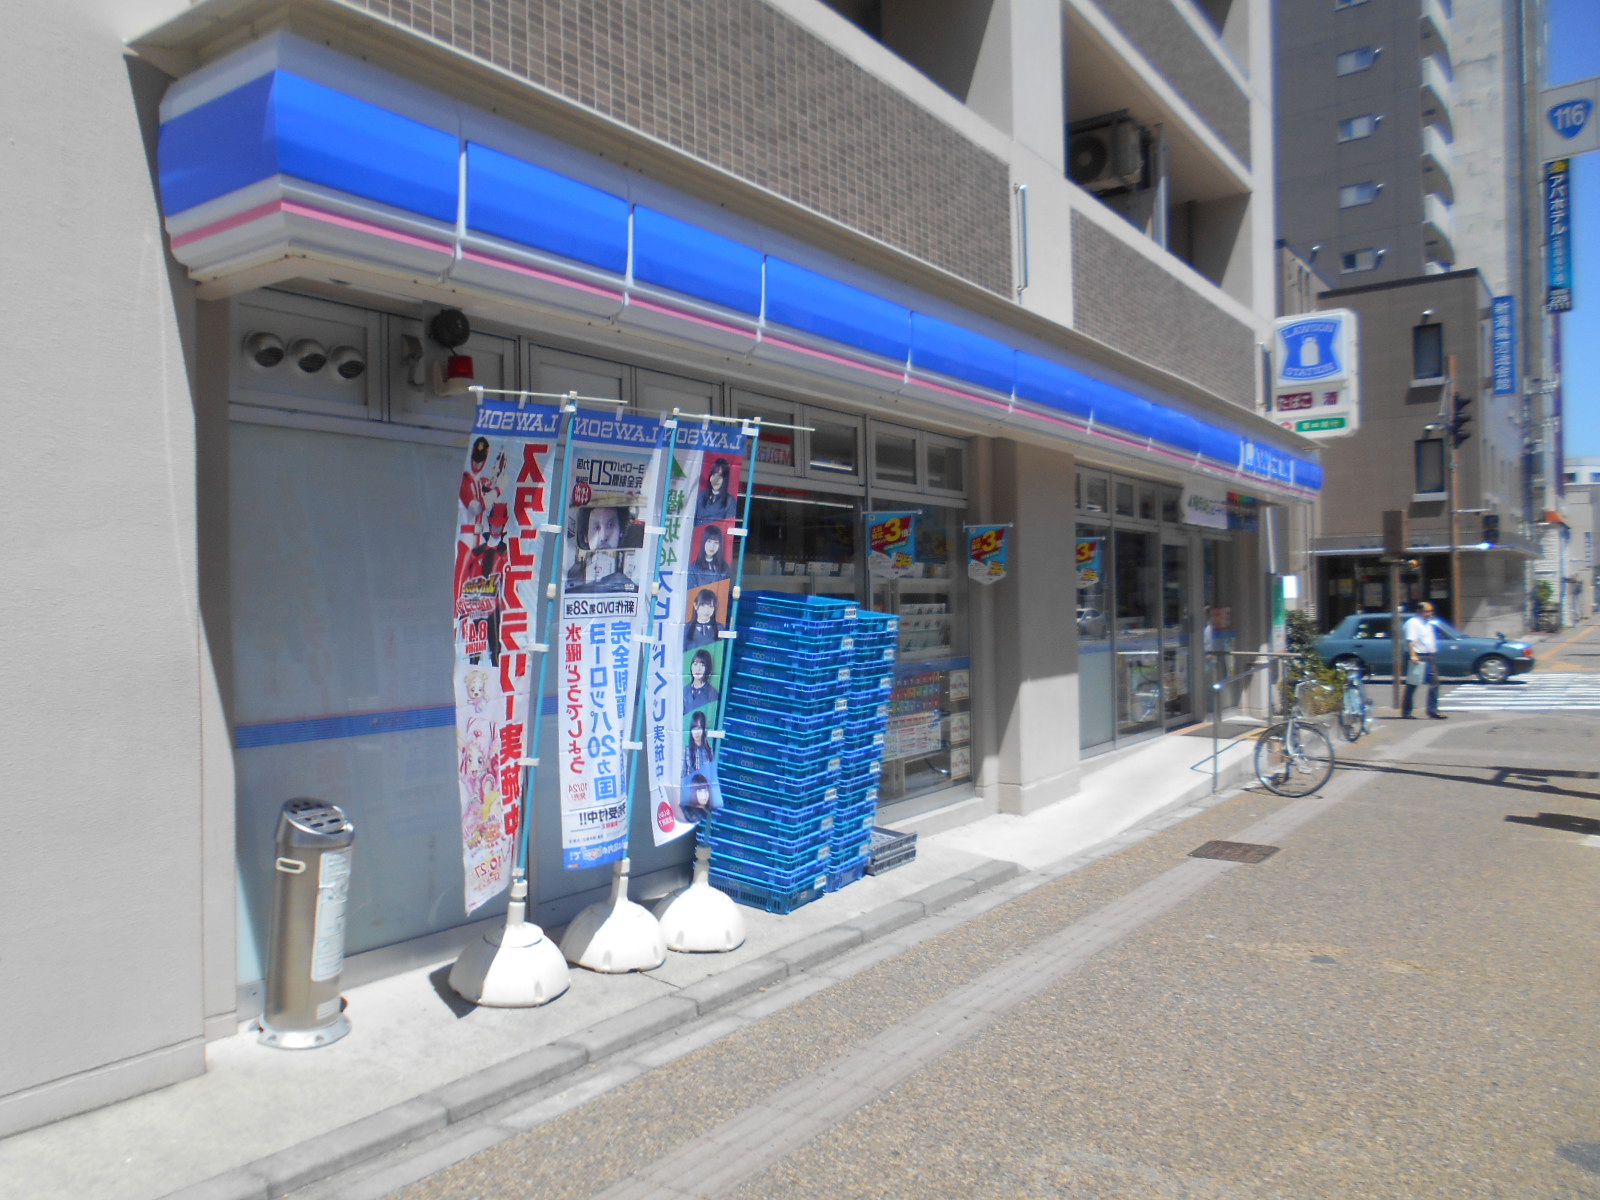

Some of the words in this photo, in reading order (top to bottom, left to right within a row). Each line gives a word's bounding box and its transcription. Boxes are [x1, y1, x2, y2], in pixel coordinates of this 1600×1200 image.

[1553, 104, 1585, 130] 116
[1549, 173, 1569, 235] アパホテル
[884, 517, 902, 542] 3
[981, 530, 996, 552] 3
[1075, 542, 1090, 561] 3
